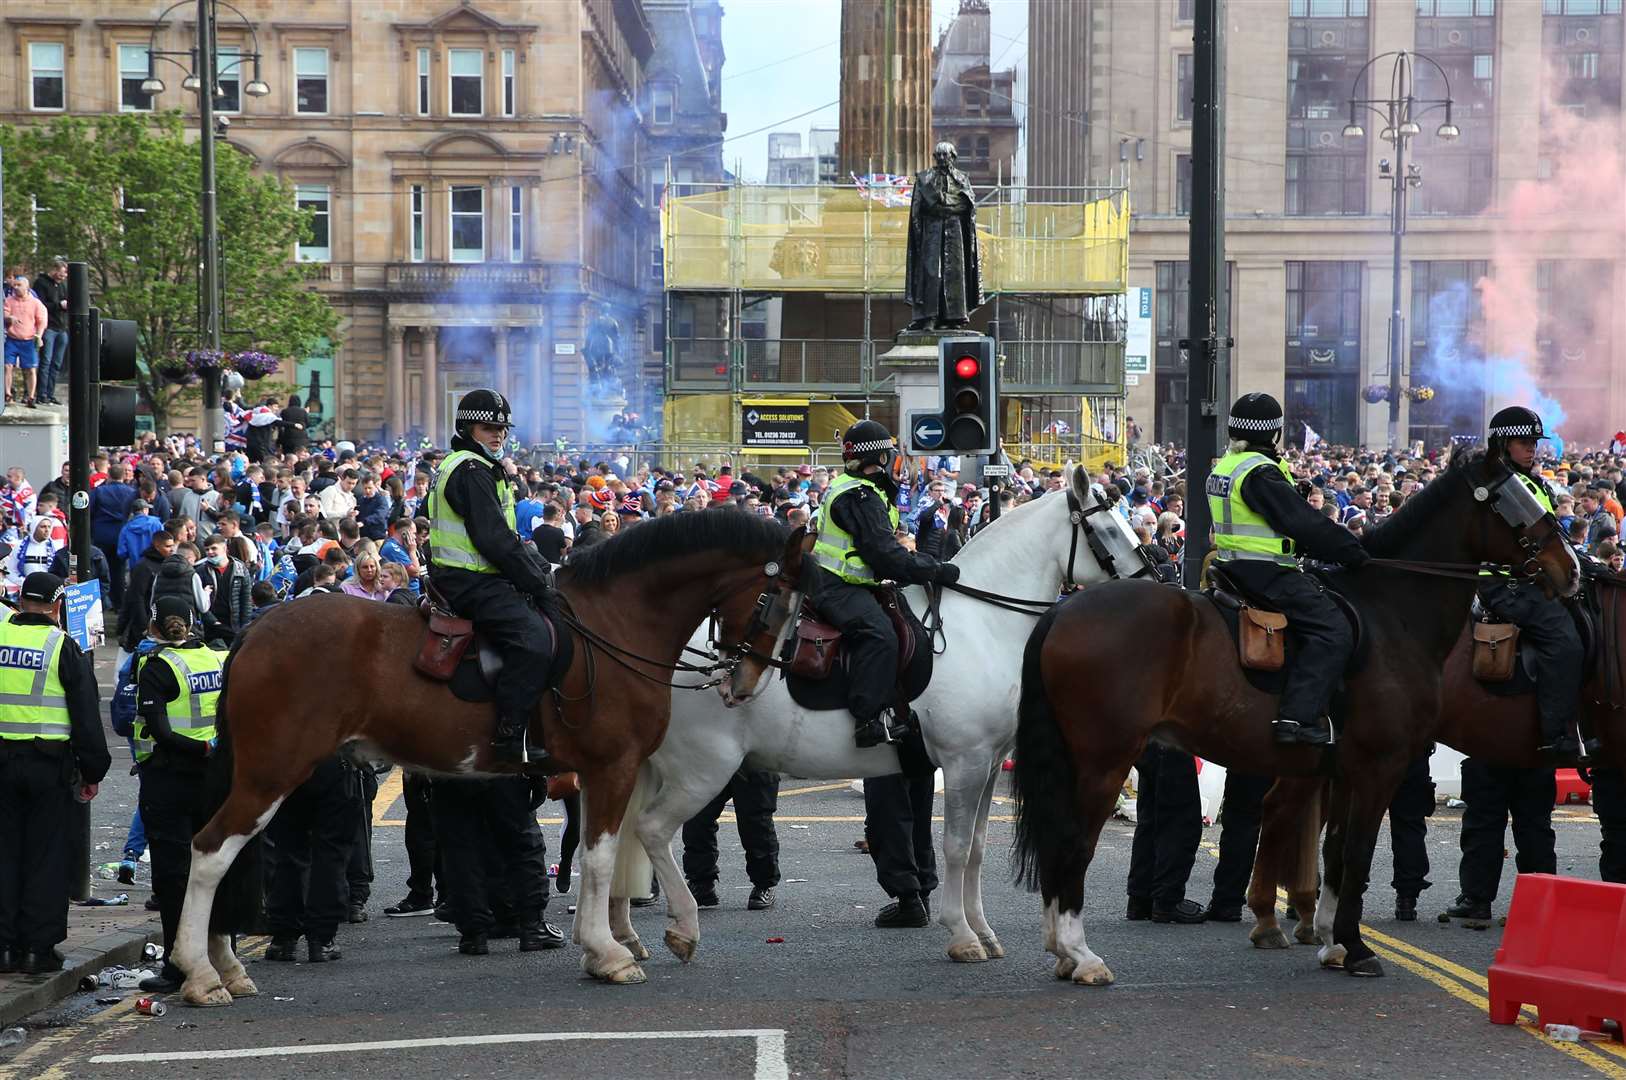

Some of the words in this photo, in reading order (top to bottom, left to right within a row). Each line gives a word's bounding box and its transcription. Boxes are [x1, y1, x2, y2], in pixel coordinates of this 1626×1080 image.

[1141, 291, 1149, 304] LET
[1141, 304, 1149, 315] TO
[1207, 476, 1229, 495] POLICE
[73, 594, 94, 604] waiting
[68, 605, 77, 613] for
[77, 604, 88, 613] you
[0, 648, 43, 668] OLICE
[191, 672, 223, 691] POLIC
